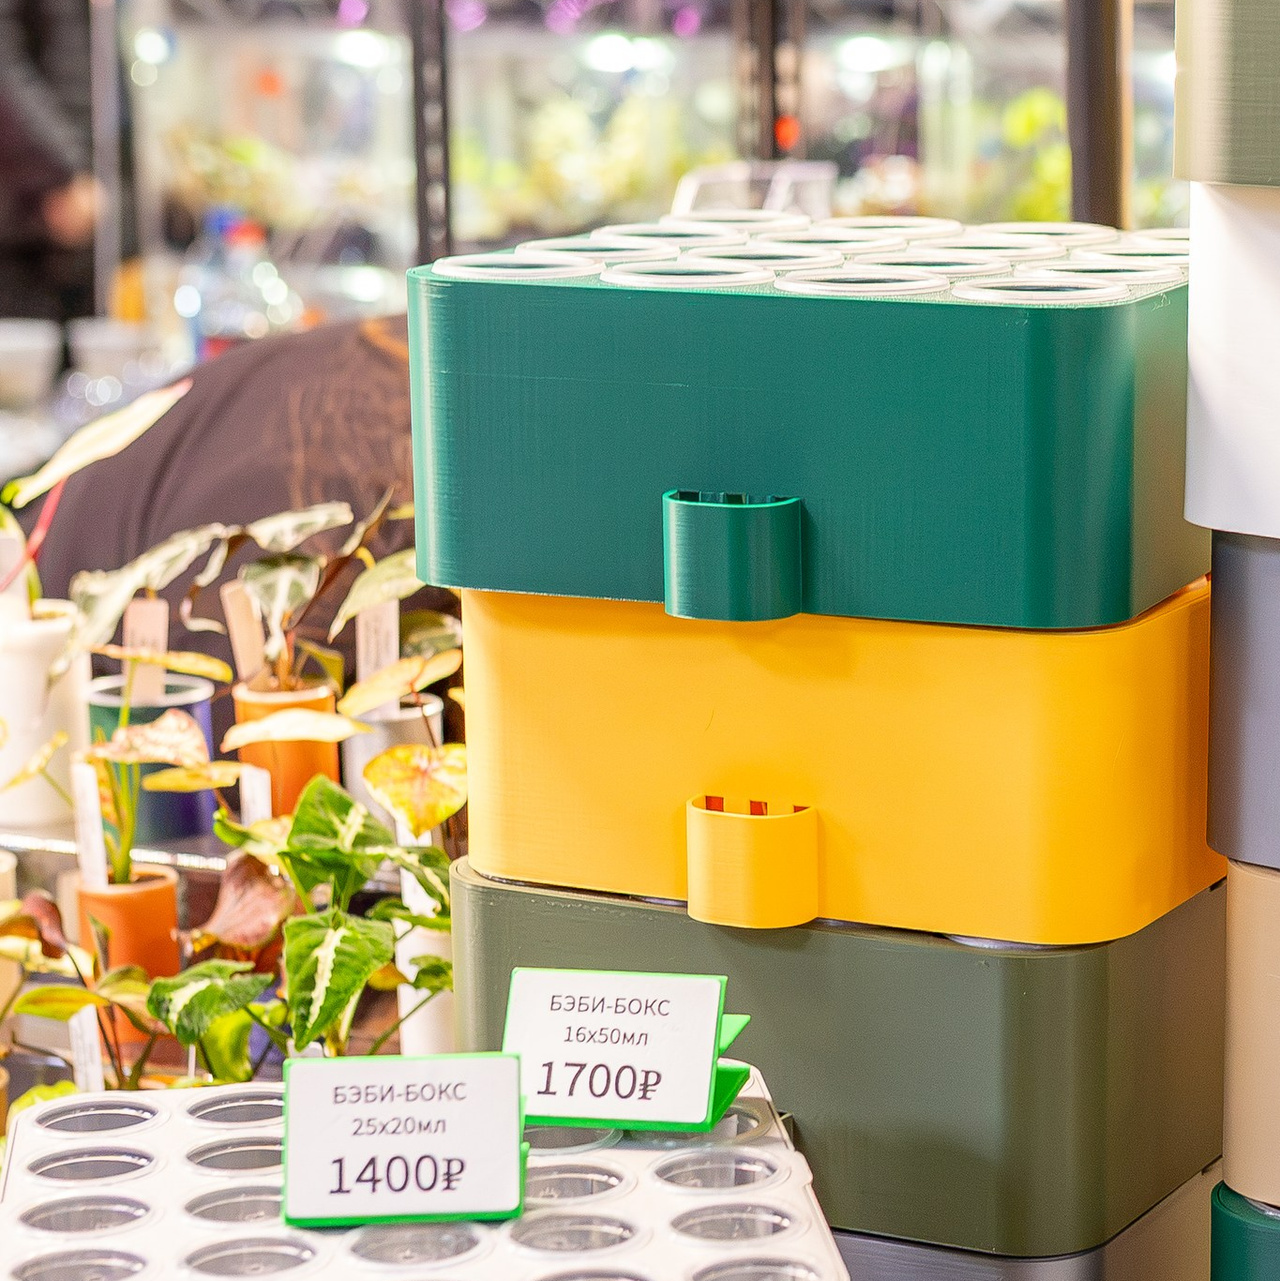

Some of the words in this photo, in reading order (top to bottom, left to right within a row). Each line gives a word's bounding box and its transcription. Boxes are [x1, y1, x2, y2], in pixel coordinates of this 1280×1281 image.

[550, 994, 671, 1017] БЭБИ-БОКС
[333, 1082, 466, 1104] БЭБИ-БОКС
[536, 1061, 662, 1101] 1700₽
[329, 1154, 466, 1195] 1400₽
